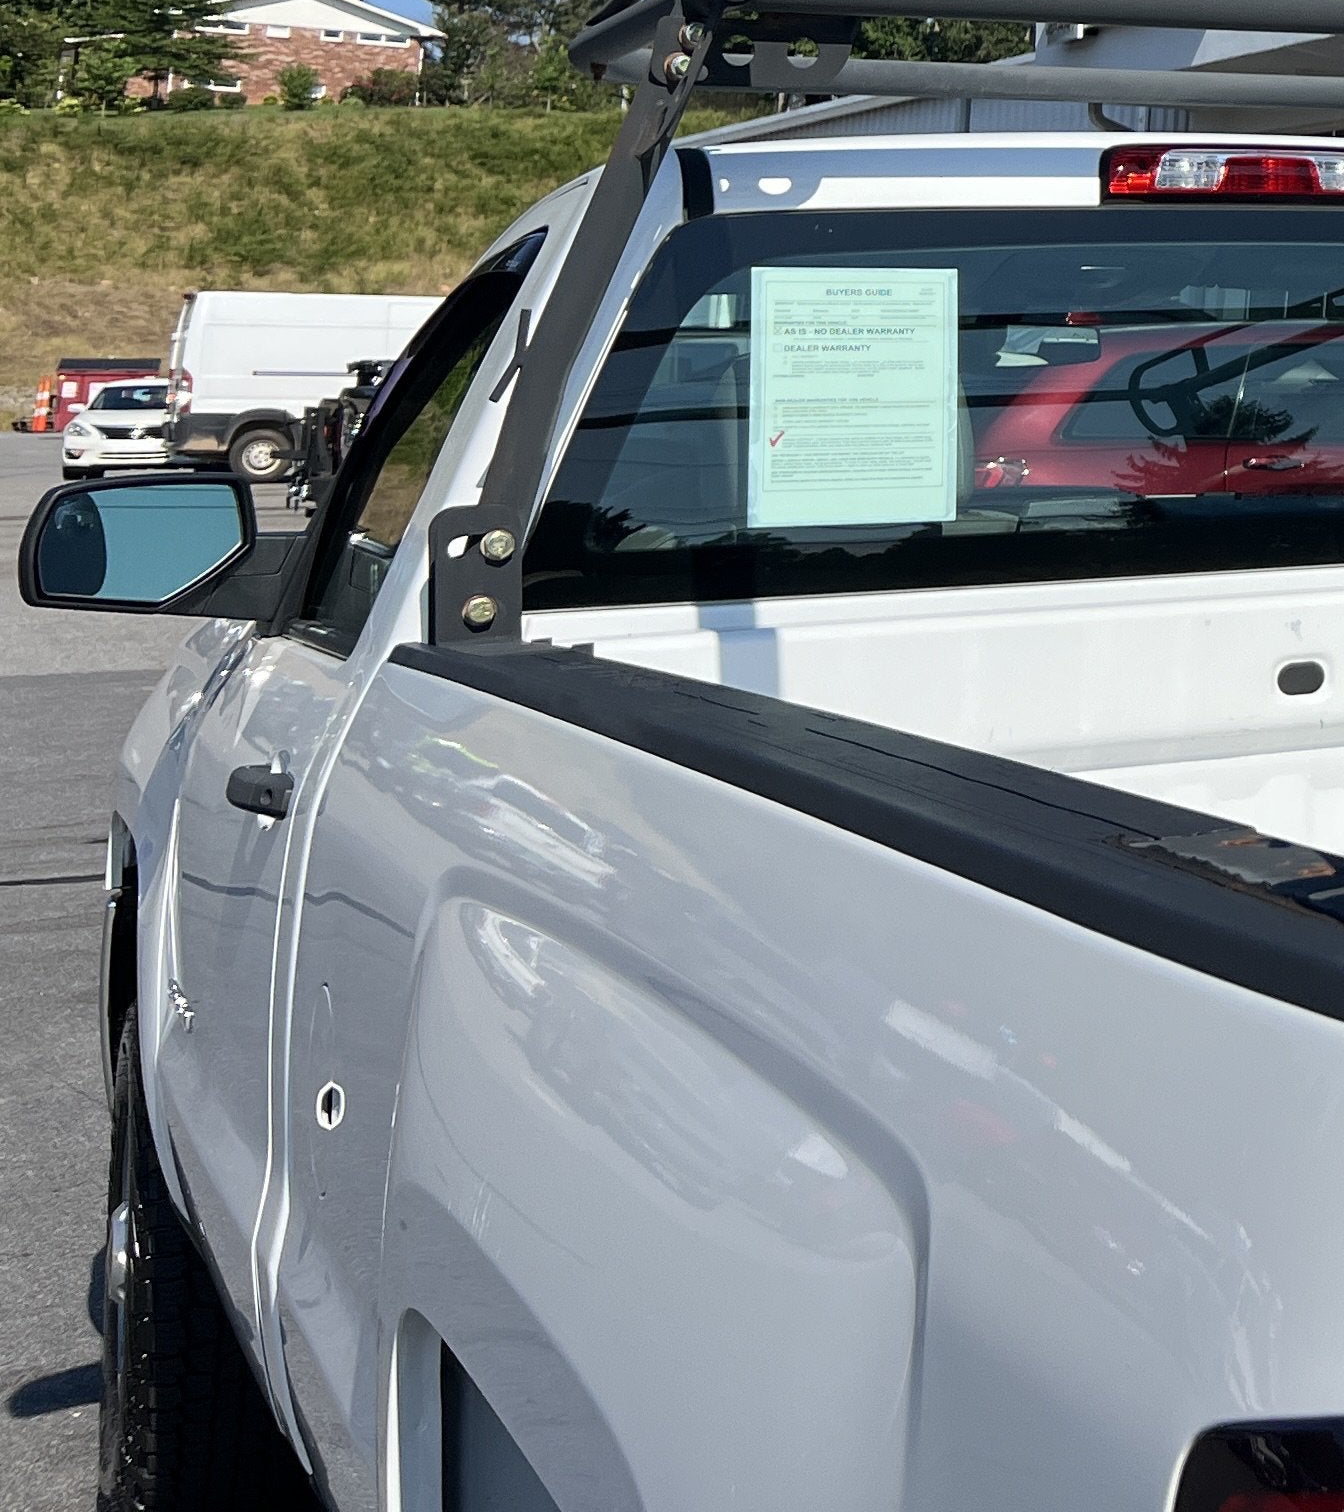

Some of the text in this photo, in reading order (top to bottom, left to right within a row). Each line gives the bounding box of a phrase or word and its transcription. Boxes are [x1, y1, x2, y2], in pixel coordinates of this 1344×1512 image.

[825, 288, 893, 297] BUYERS GUIDE
[783, 327, 797, 336] AS
[813, 327, 828, 336] NO
[829, 327, 865, 336] DEALER
[866, 327, 916, 336] WARRANTY
[783, 344, 872, 353] DEALER WARRANTY
